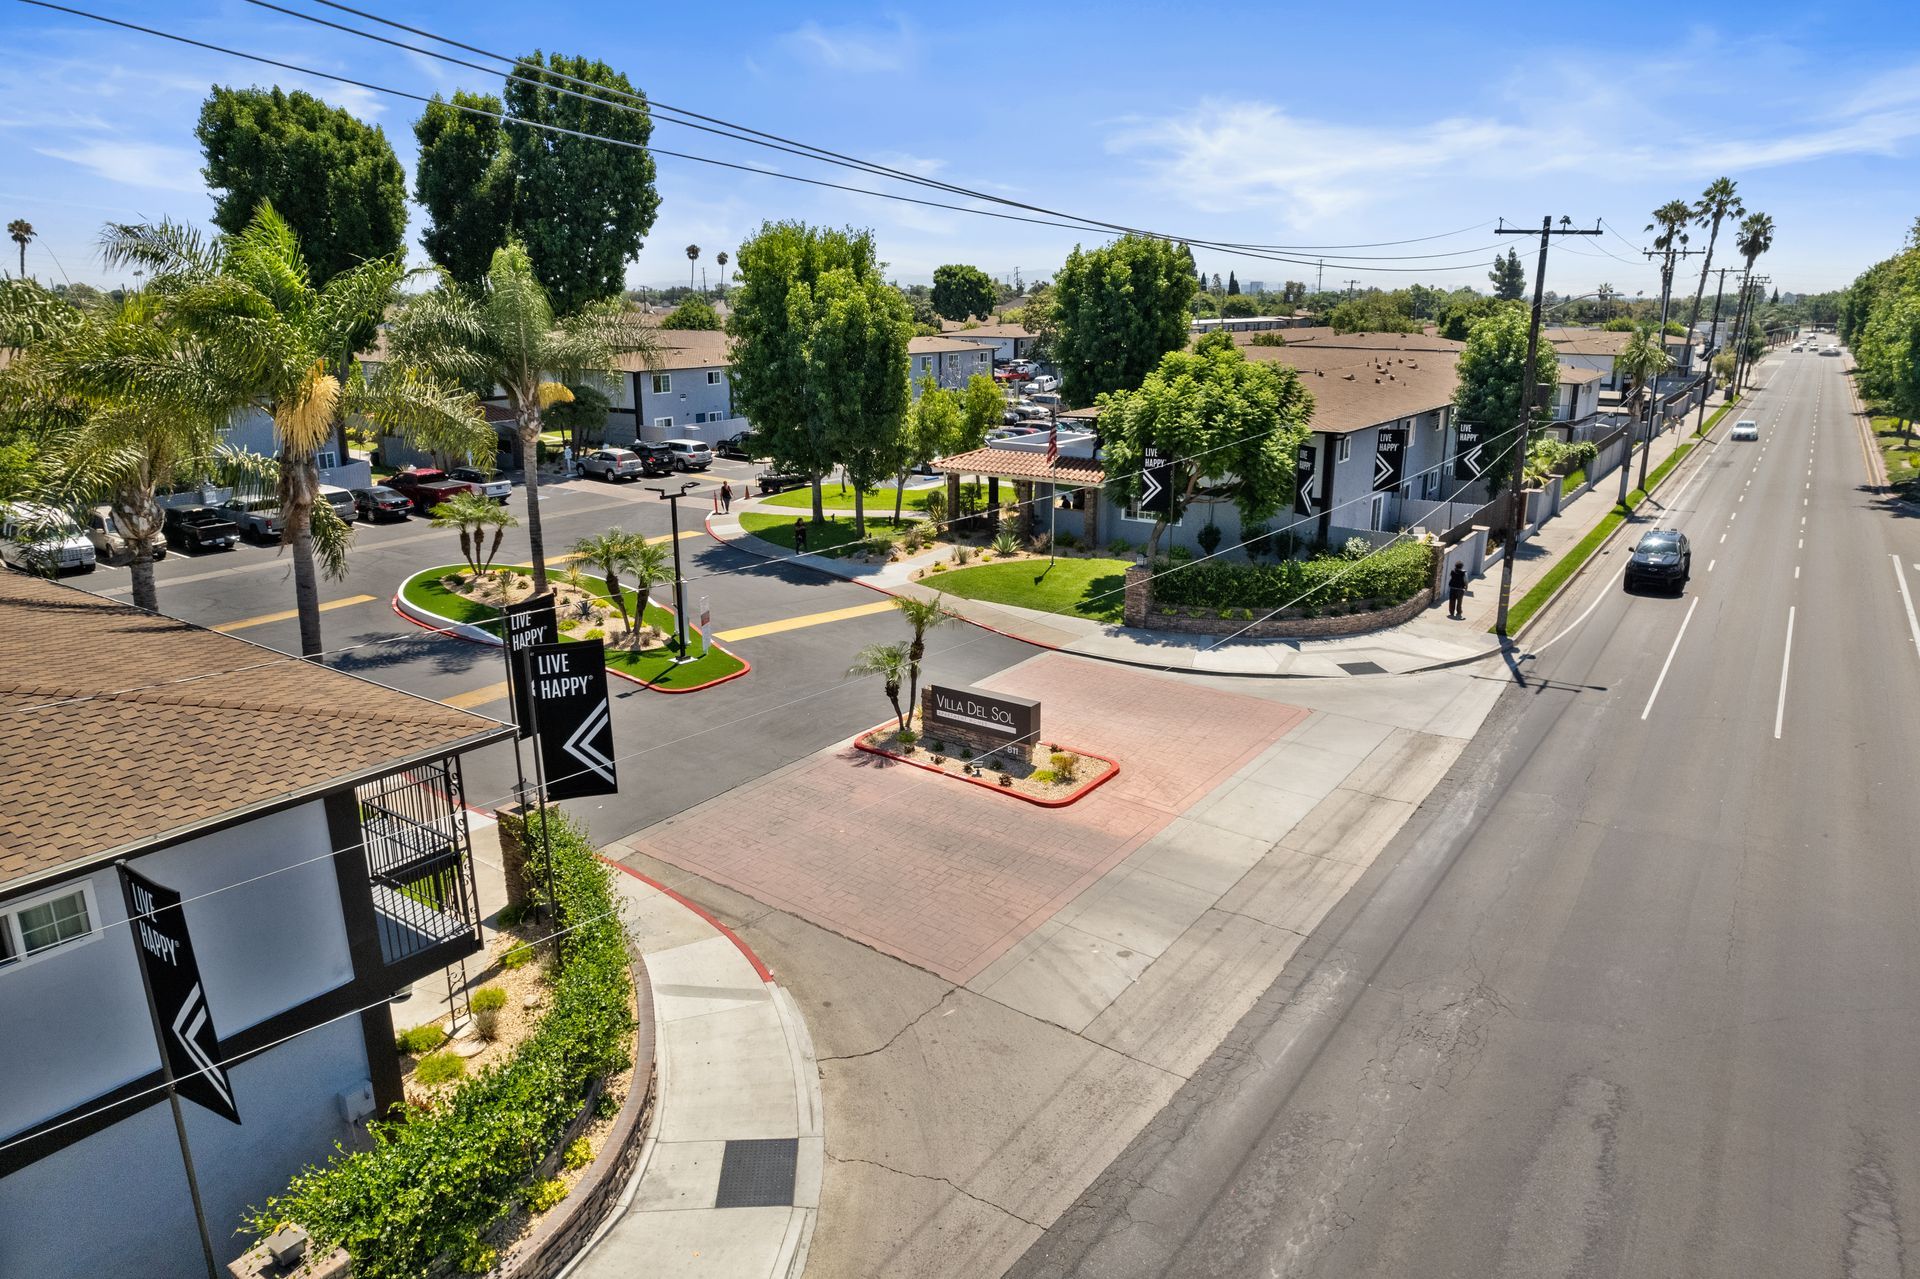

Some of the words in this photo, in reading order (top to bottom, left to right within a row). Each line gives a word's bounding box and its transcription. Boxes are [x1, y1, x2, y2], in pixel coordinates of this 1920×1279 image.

[1380, 433, 1392, 442] LIVE
[1145, 447, 1158, 457] LIVE
[1379, 443, 1398, 452] HAPPY
[1145, 458, 1165, 468] HAPPY
[511, 614, 531, 630] LIVE
[512, 626, 544, 651] HAPPY
[538, 653, 570, 675] LIVE
[540, 675, 588, 700] HAPPY
[1007, 745, 1019, 755] 811
[131, 882, 157, 923] LIVE
[138, 919, 177, 967] HAPPY
